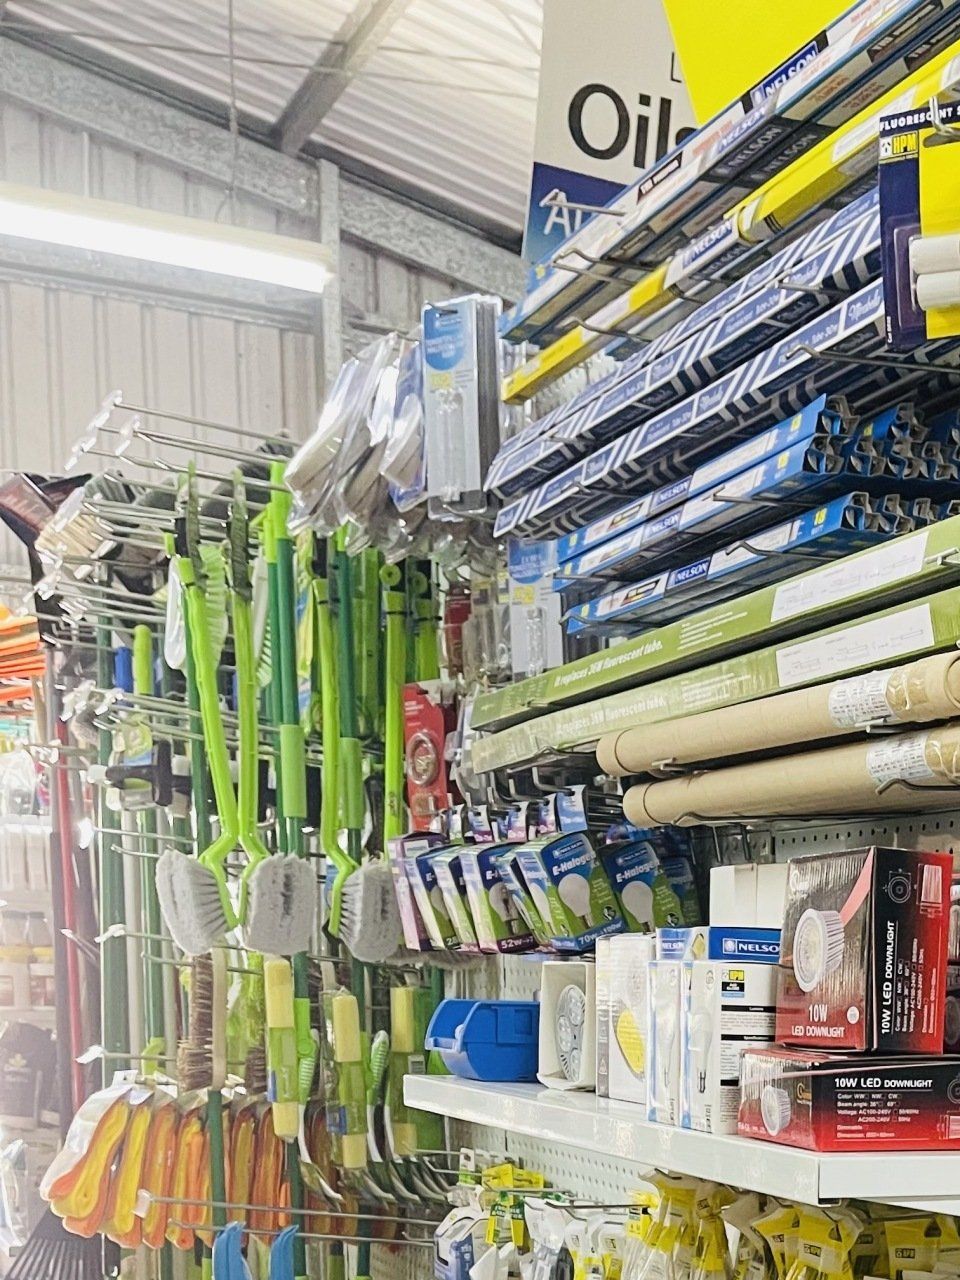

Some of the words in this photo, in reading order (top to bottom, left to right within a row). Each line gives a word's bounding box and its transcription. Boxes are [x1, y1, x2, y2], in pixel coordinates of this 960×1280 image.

[765, 49, 818, 98] NELSON
[880, 107, 953, 131] FLUORESCNT
[892, 133, 917, 154] HPM
[676, 559, 710, 584] NELSON
[739, 943, 780, 953] NELSO
[885, 921, 895, 979] DOWNLIGHT
[882, 982, 892, 1005] LED
[808, 1004, 828, 1023] 10W
[881, 1009, 891, 1034] 10W
[791, 1025, 805, 1037] LED
[806, 1026, 845, 1038] DOWNLIGHT
[835, 1078, 857, 1088] 10W
[861, 1077, 882, 1088] LED
[884, 1079, 933, 1088] DOWNLIGHT
